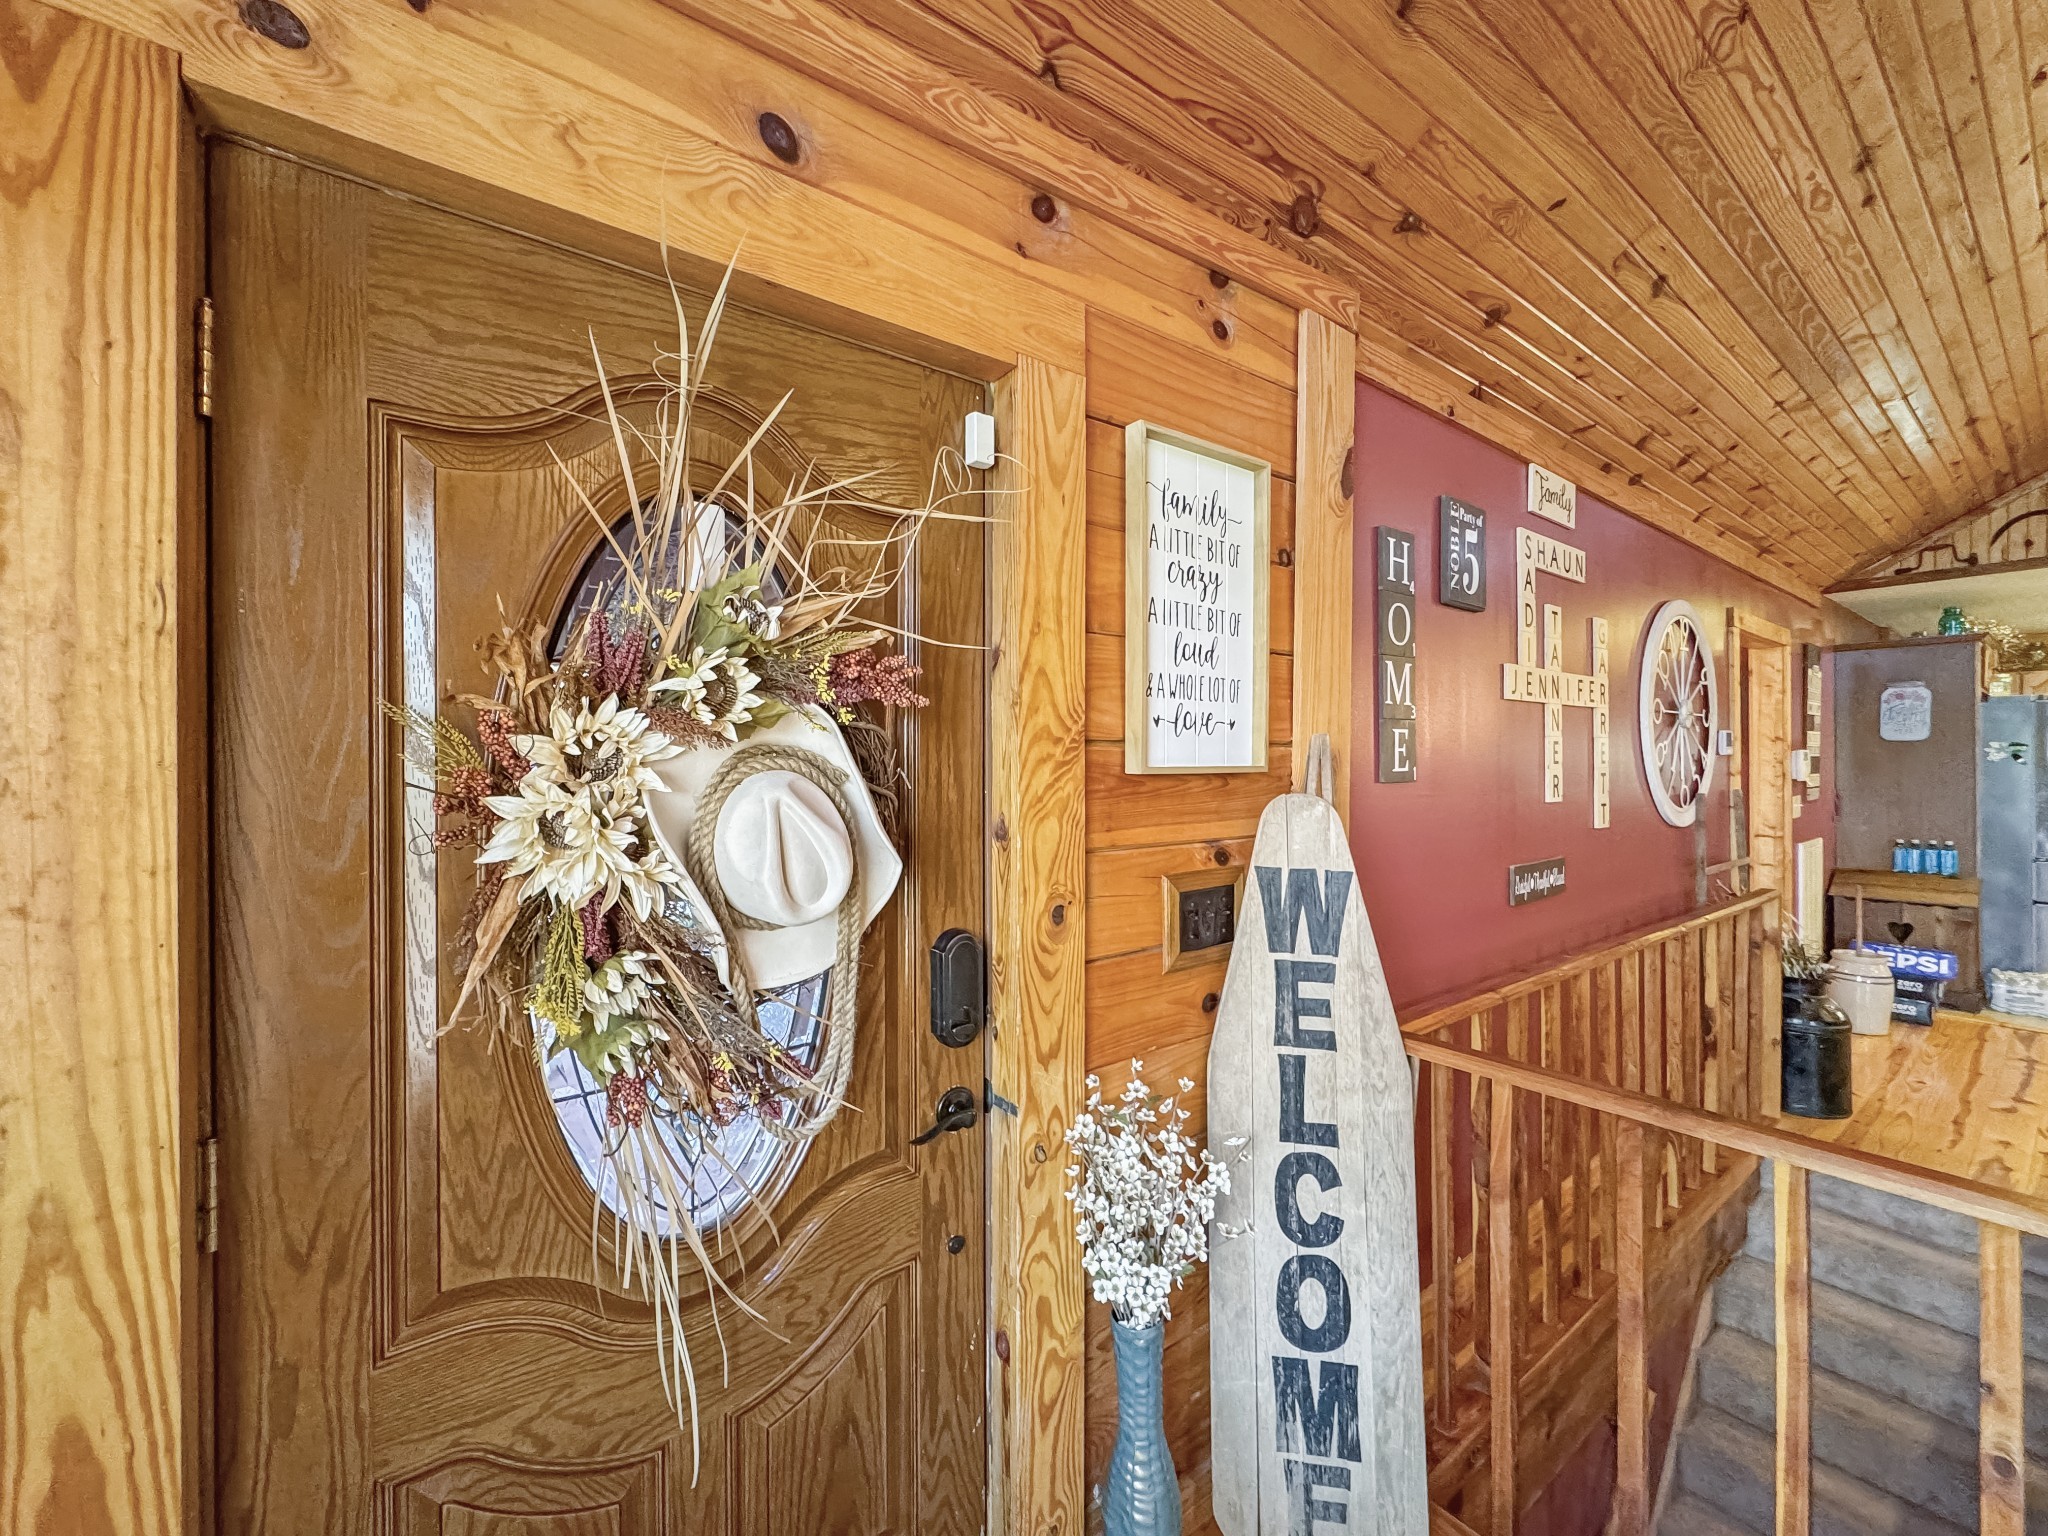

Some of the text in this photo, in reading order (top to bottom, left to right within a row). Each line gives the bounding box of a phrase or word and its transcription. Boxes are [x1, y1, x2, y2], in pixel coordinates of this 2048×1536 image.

[1147, 478, 1242, 538] family
[1460, 507, 1484, 529] Party of
[1535, 470, 1573, 523] Family
[1149, 523, 1241, 568] A LITTLE BIT OF
[1449, 501, 1460, 590] NOBLE
[1462, 528, 1480, 596] 5
[1524, 535, 1584, 578] SHAUN
[1168, 560, 1223, 604] crazy
[1148, 596, 1242, 637] A LITTLE BIT OF
[1174, 631, 1219, 670] loud
[1384, 536, 1413, 773] HOME
[1145, 672, 1241, 703] & A WHOLE LOT OF
[1511, 669, 1607, 705] JENNIFER
[1550, 610, 1561, 798] TANNER
[1170, 703, 1224, 737] love
[1598, 622, 1608, 825] GARRETT
[1861, 948, 1949, 975] EPSI
[1254, 866, 1362, 1536] WELCOME
